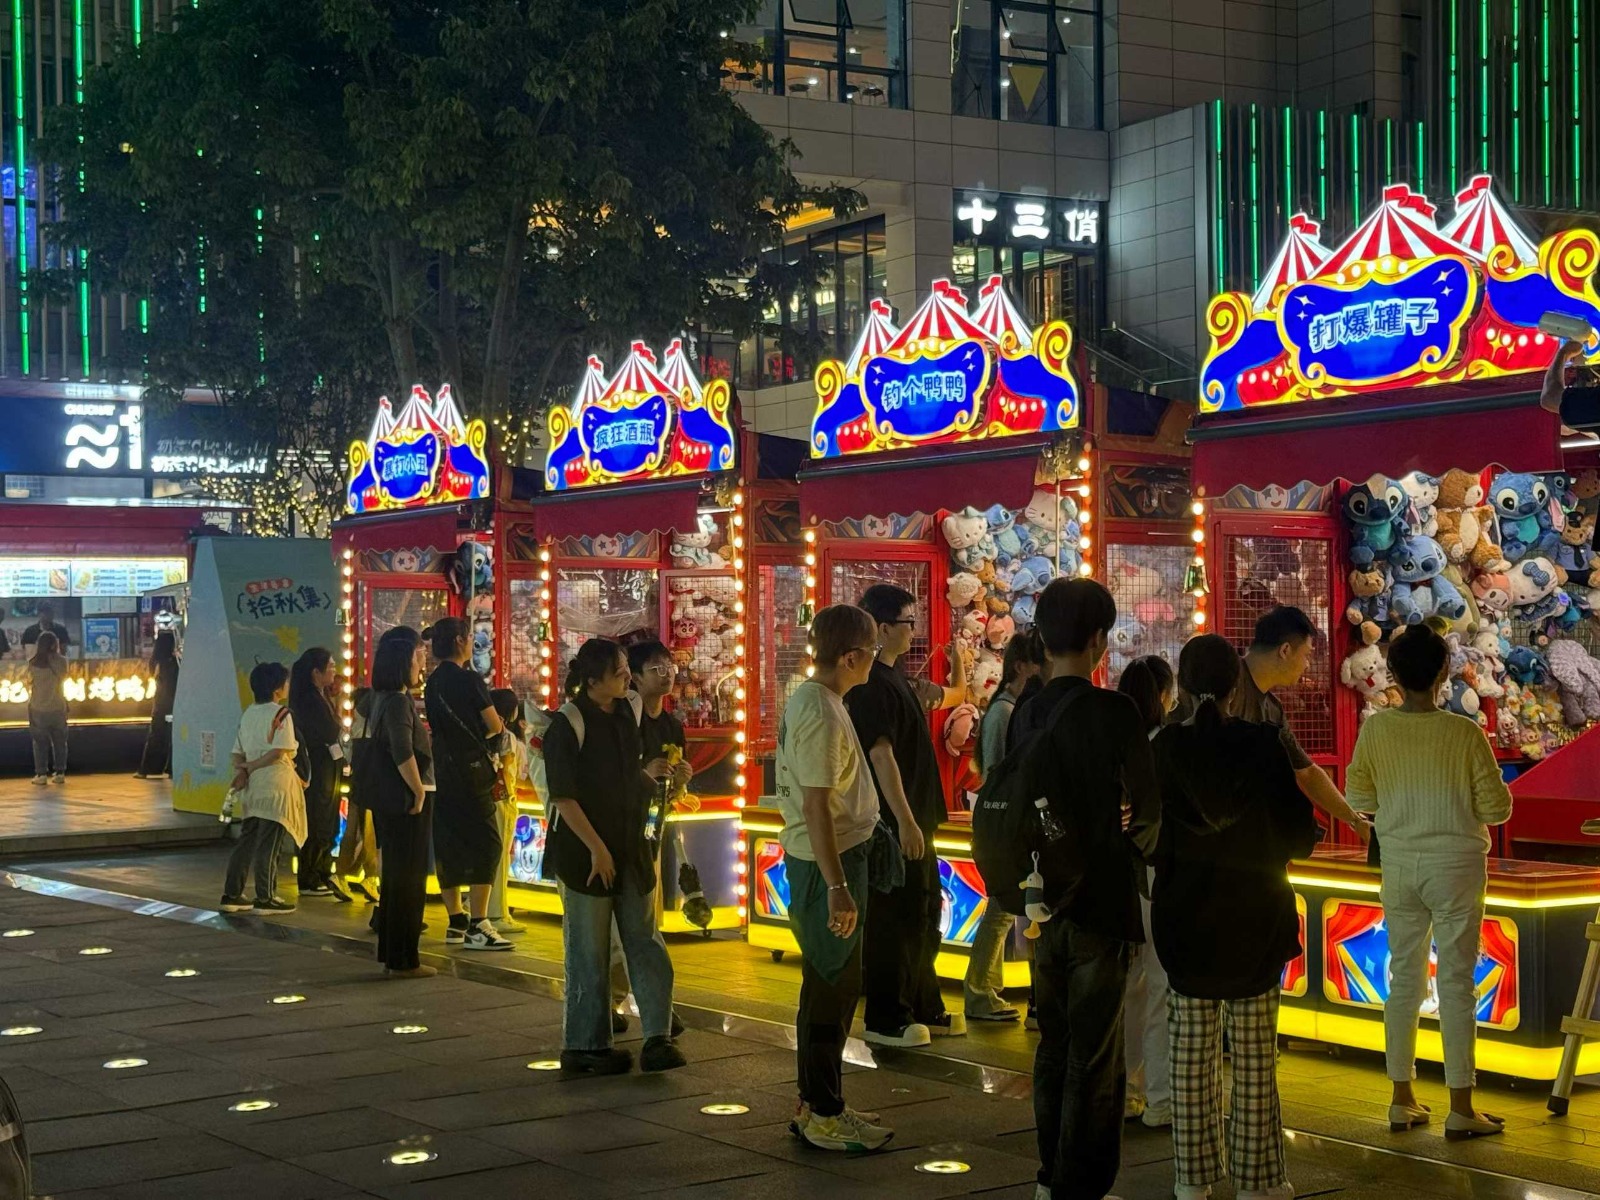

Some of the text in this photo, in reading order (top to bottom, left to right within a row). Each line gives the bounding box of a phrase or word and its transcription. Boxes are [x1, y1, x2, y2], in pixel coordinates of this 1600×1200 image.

[957, 197, 1098, 243] 十三俏
[1308, 298, 1439, 352] 打爆罐子
[881, 371, 966, 412] 钓个鸭鸭
[593, 418, 655, 453] 疯狂酒瓶
[381, 453, 428, 481] 暴打小丑
